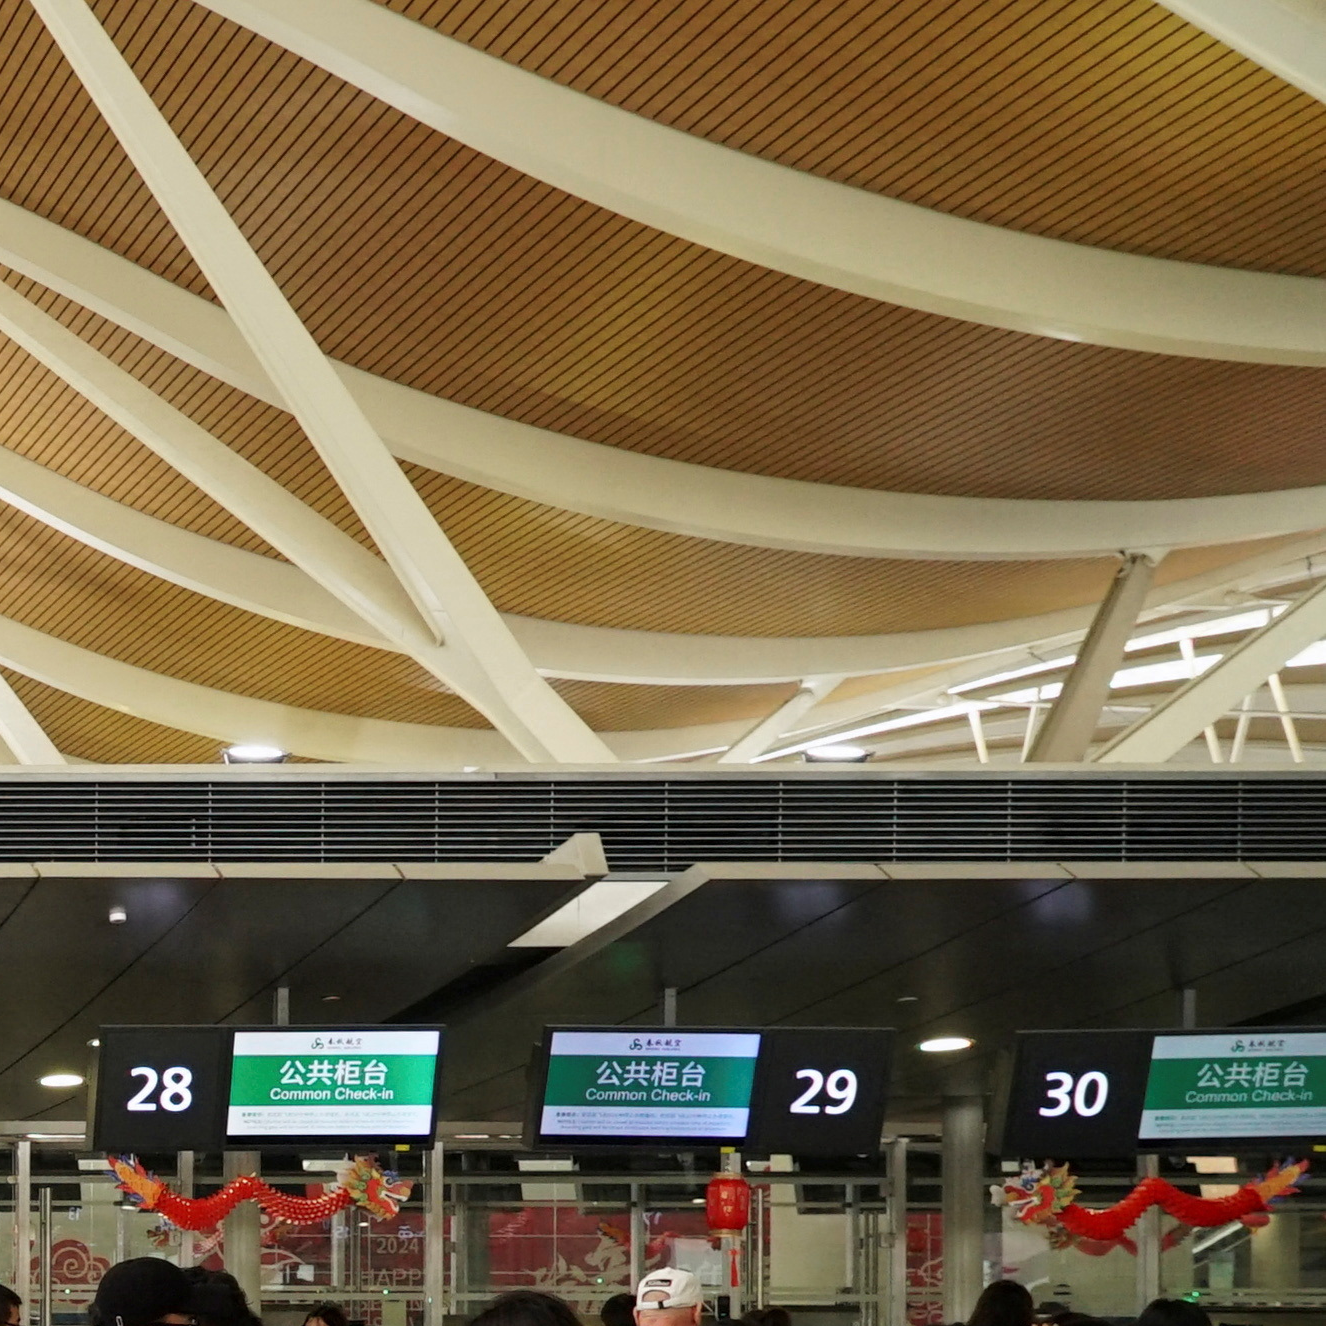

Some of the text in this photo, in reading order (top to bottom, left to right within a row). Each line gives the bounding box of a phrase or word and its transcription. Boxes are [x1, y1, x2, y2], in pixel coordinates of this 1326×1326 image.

[280, 1060, 387, 1086] 公共柜台
[596, 1061, 706, 1087] 公共柜台
[1197, 1062, 1308, 1088] 公共柜台
[127, 1067, 192, 1111] 28
[270, 1087, 394, 1100] Common Check-in
[586, 1088, 710, 1101] Common Check-in
[790, 1069, 857, 1114] 29
[1039, 1071, 1108, 1116] 30
[1185, 1089, 1313, 1103] Common Check-in
[376, 1237, 419, 1255] 2024
